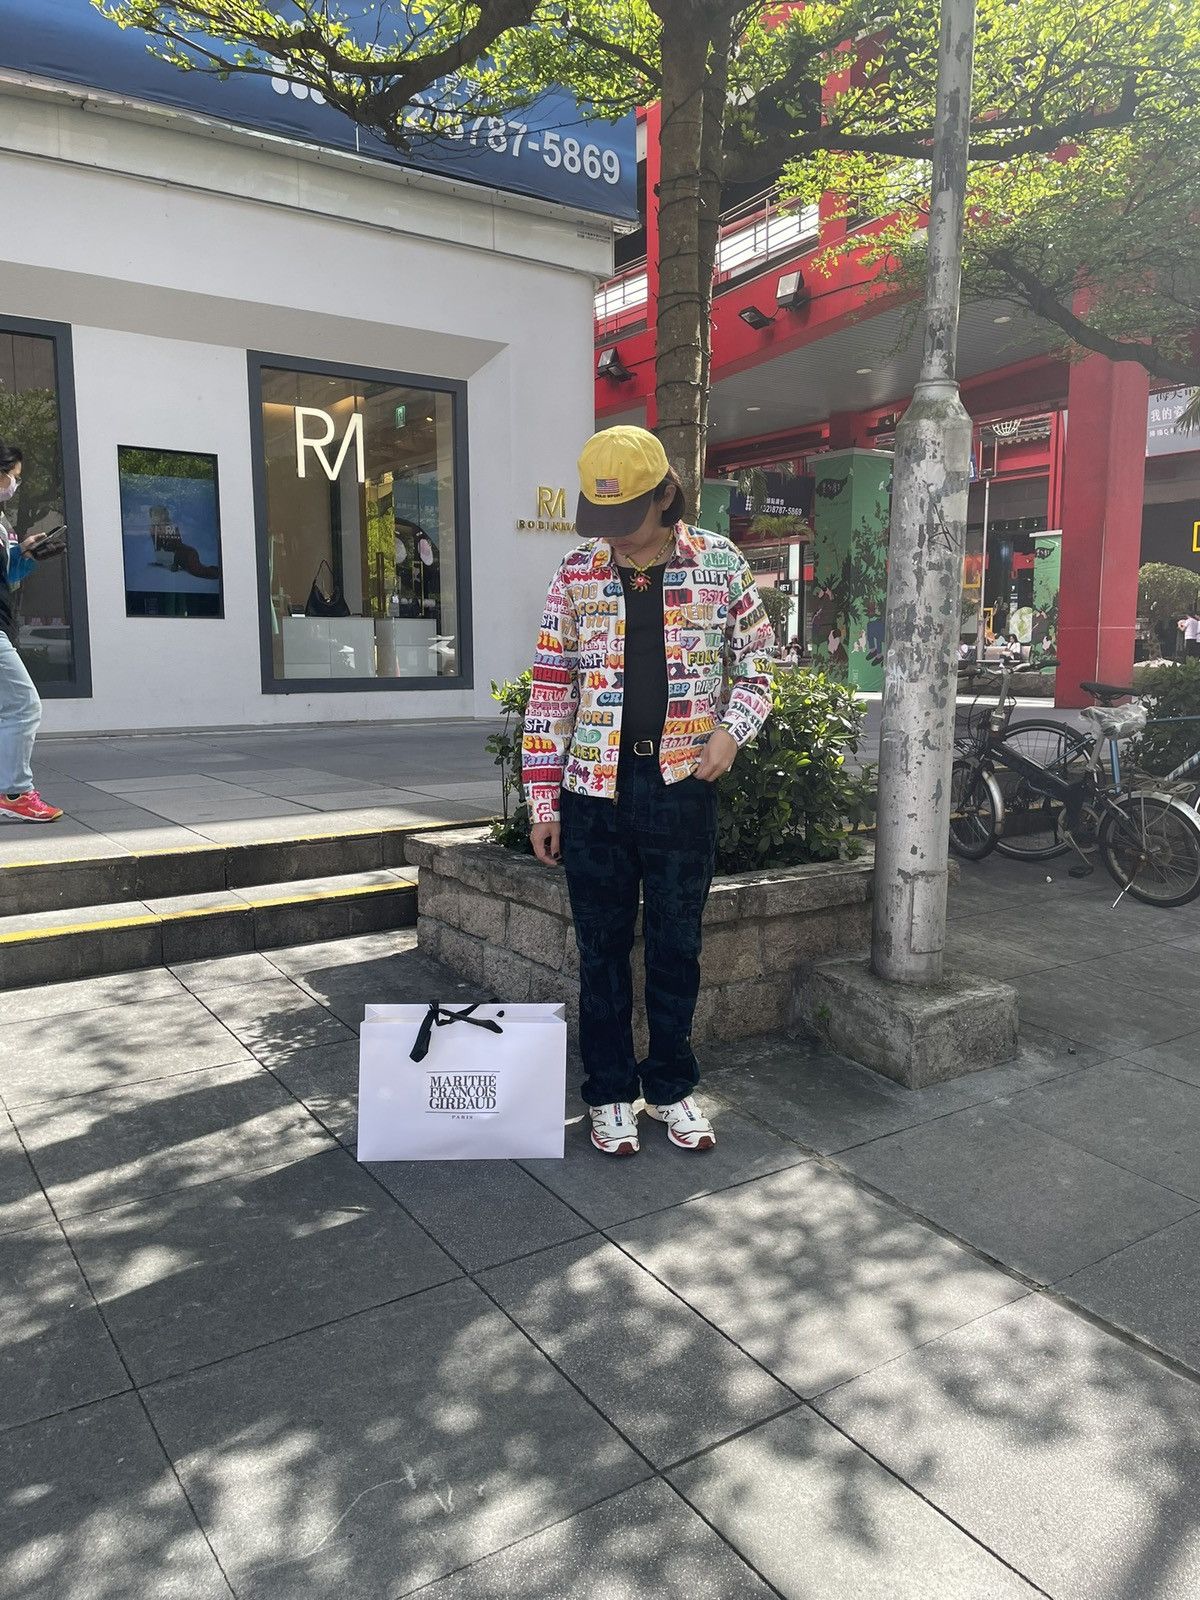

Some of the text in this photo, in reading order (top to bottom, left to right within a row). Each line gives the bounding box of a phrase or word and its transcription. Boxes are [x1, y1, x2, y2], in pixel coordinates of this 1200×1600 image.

[692, 568, 729, 585] DIRT
[523, 735, 557, 753] Sin
[430, 1073, 497, 1087] MARITHÉ
[429, 1097, 497, 1110] GIRBAUD
